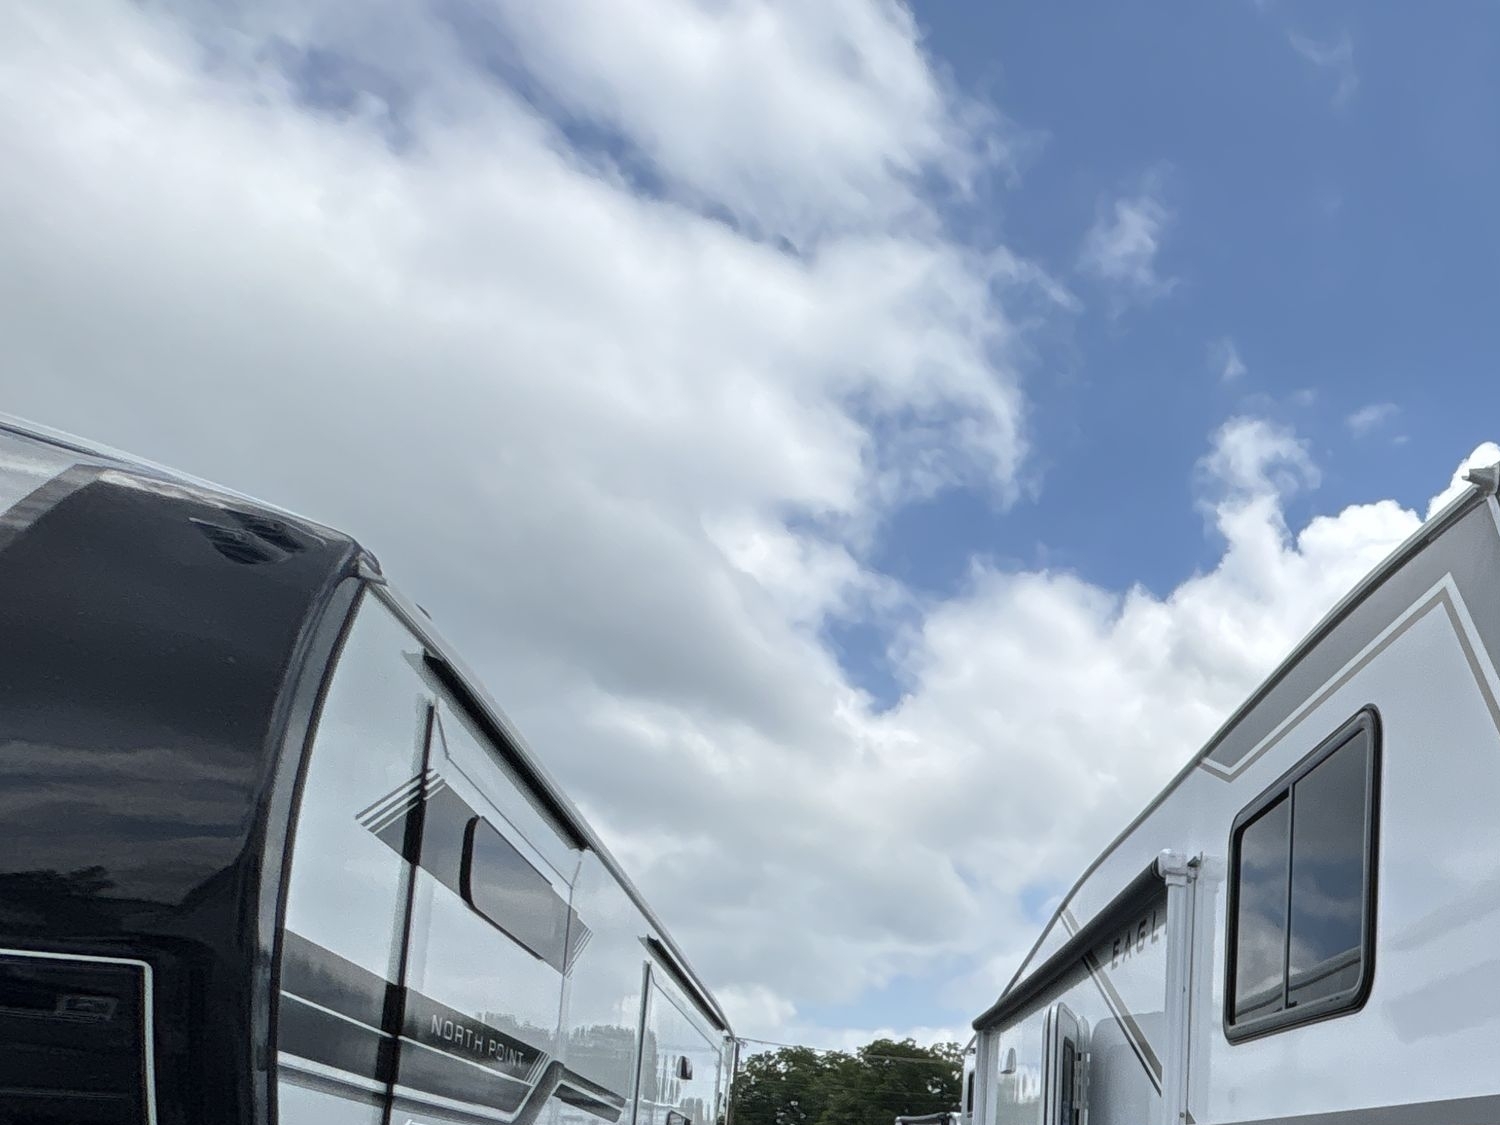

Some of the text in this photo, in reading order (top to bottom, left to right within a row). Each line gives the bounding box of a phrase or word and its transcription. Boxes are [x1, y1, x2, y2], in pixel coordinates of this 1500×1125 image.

[1111, 910, 1168, 970] EAGL
[430, 1014, 525, 1068] NORTH POINT
